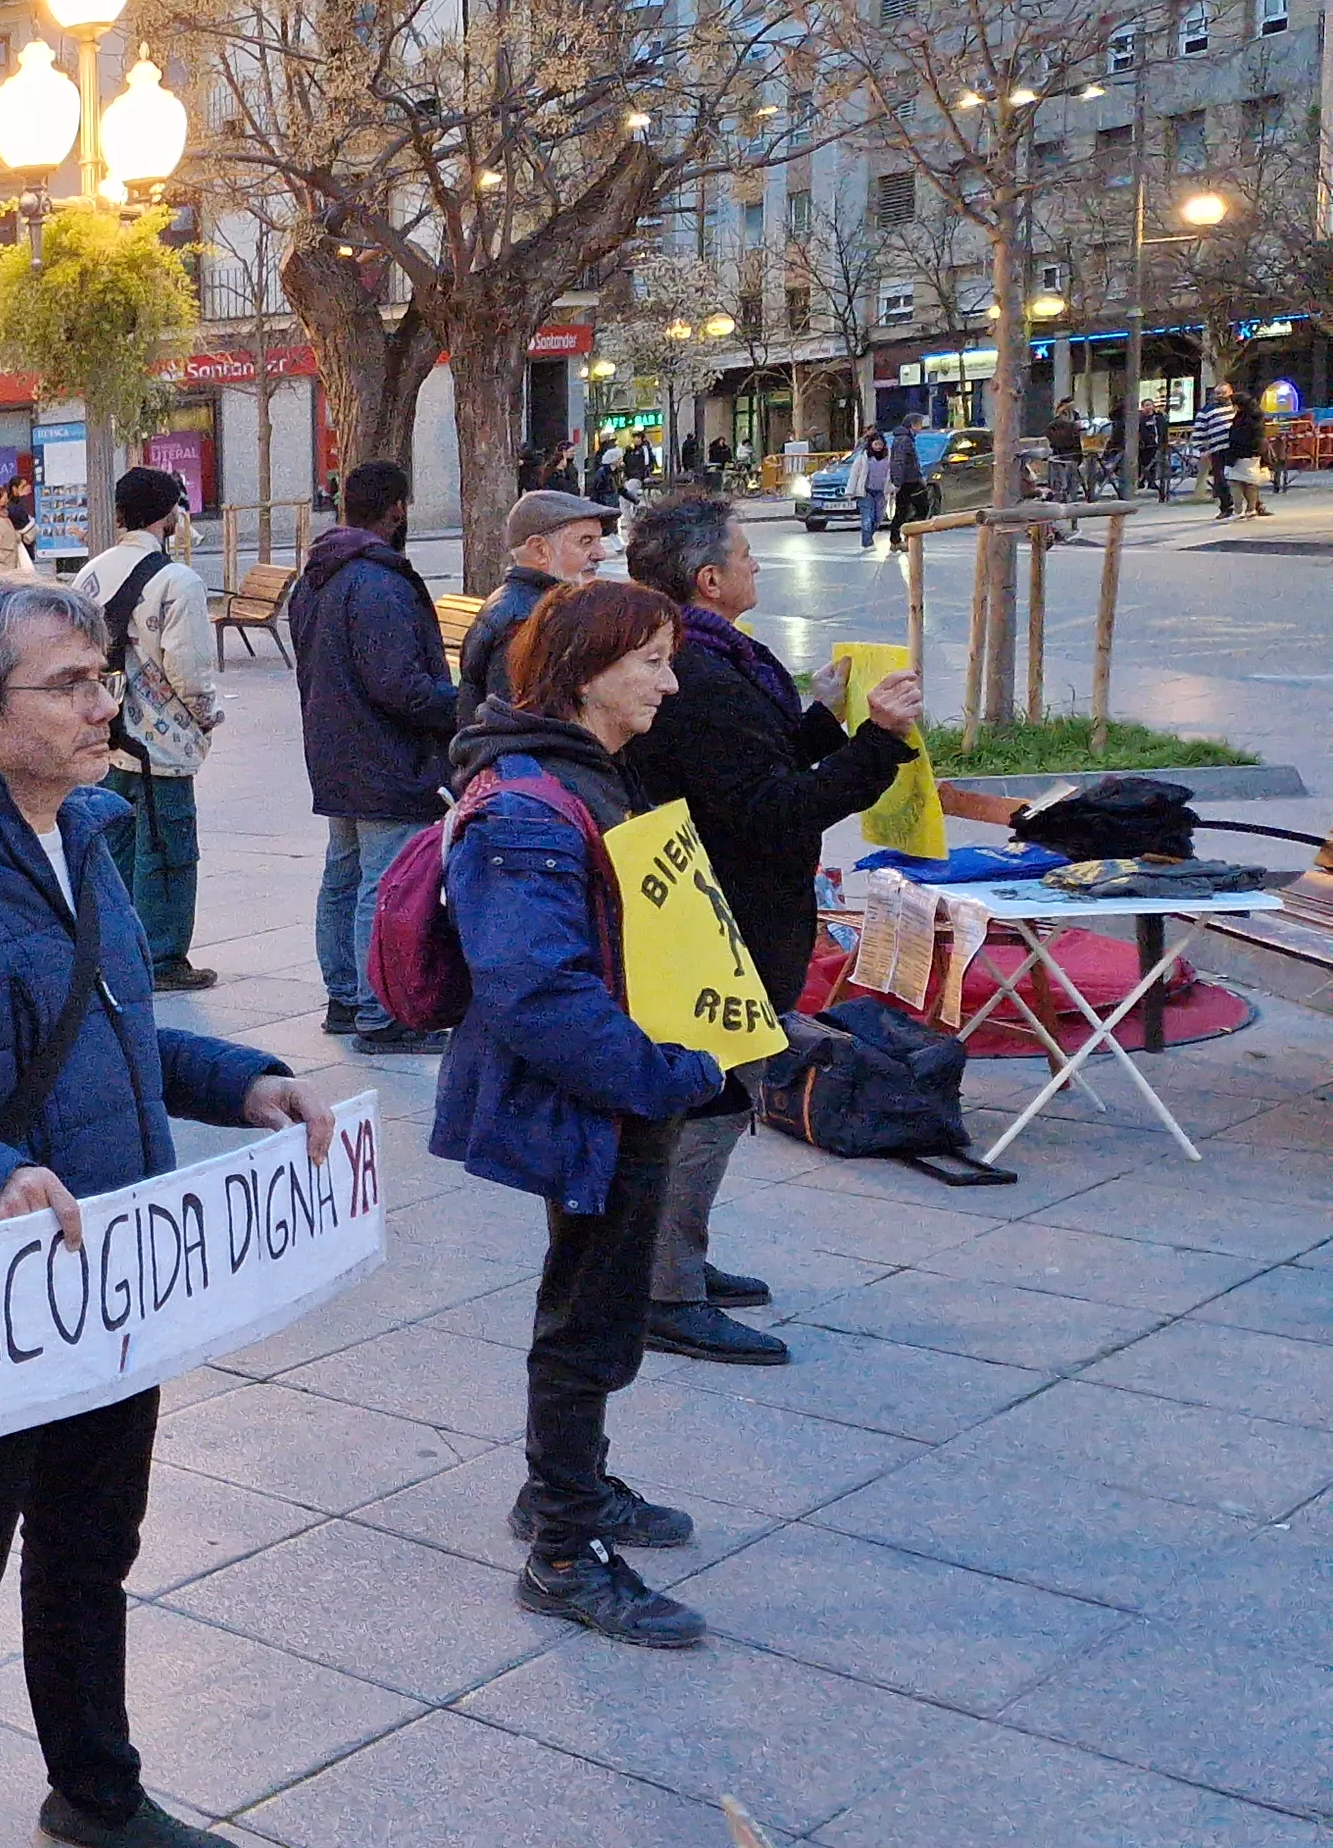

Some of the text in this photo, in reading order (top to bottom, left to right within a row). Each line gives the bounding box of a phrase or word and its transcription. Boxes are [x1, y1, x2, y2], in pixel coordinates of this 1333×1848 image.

[535, 332, 578, 350] Santander
[225, 1152, 339, 1275] DIGNA
[340, 1118, 379, 1219] YA
